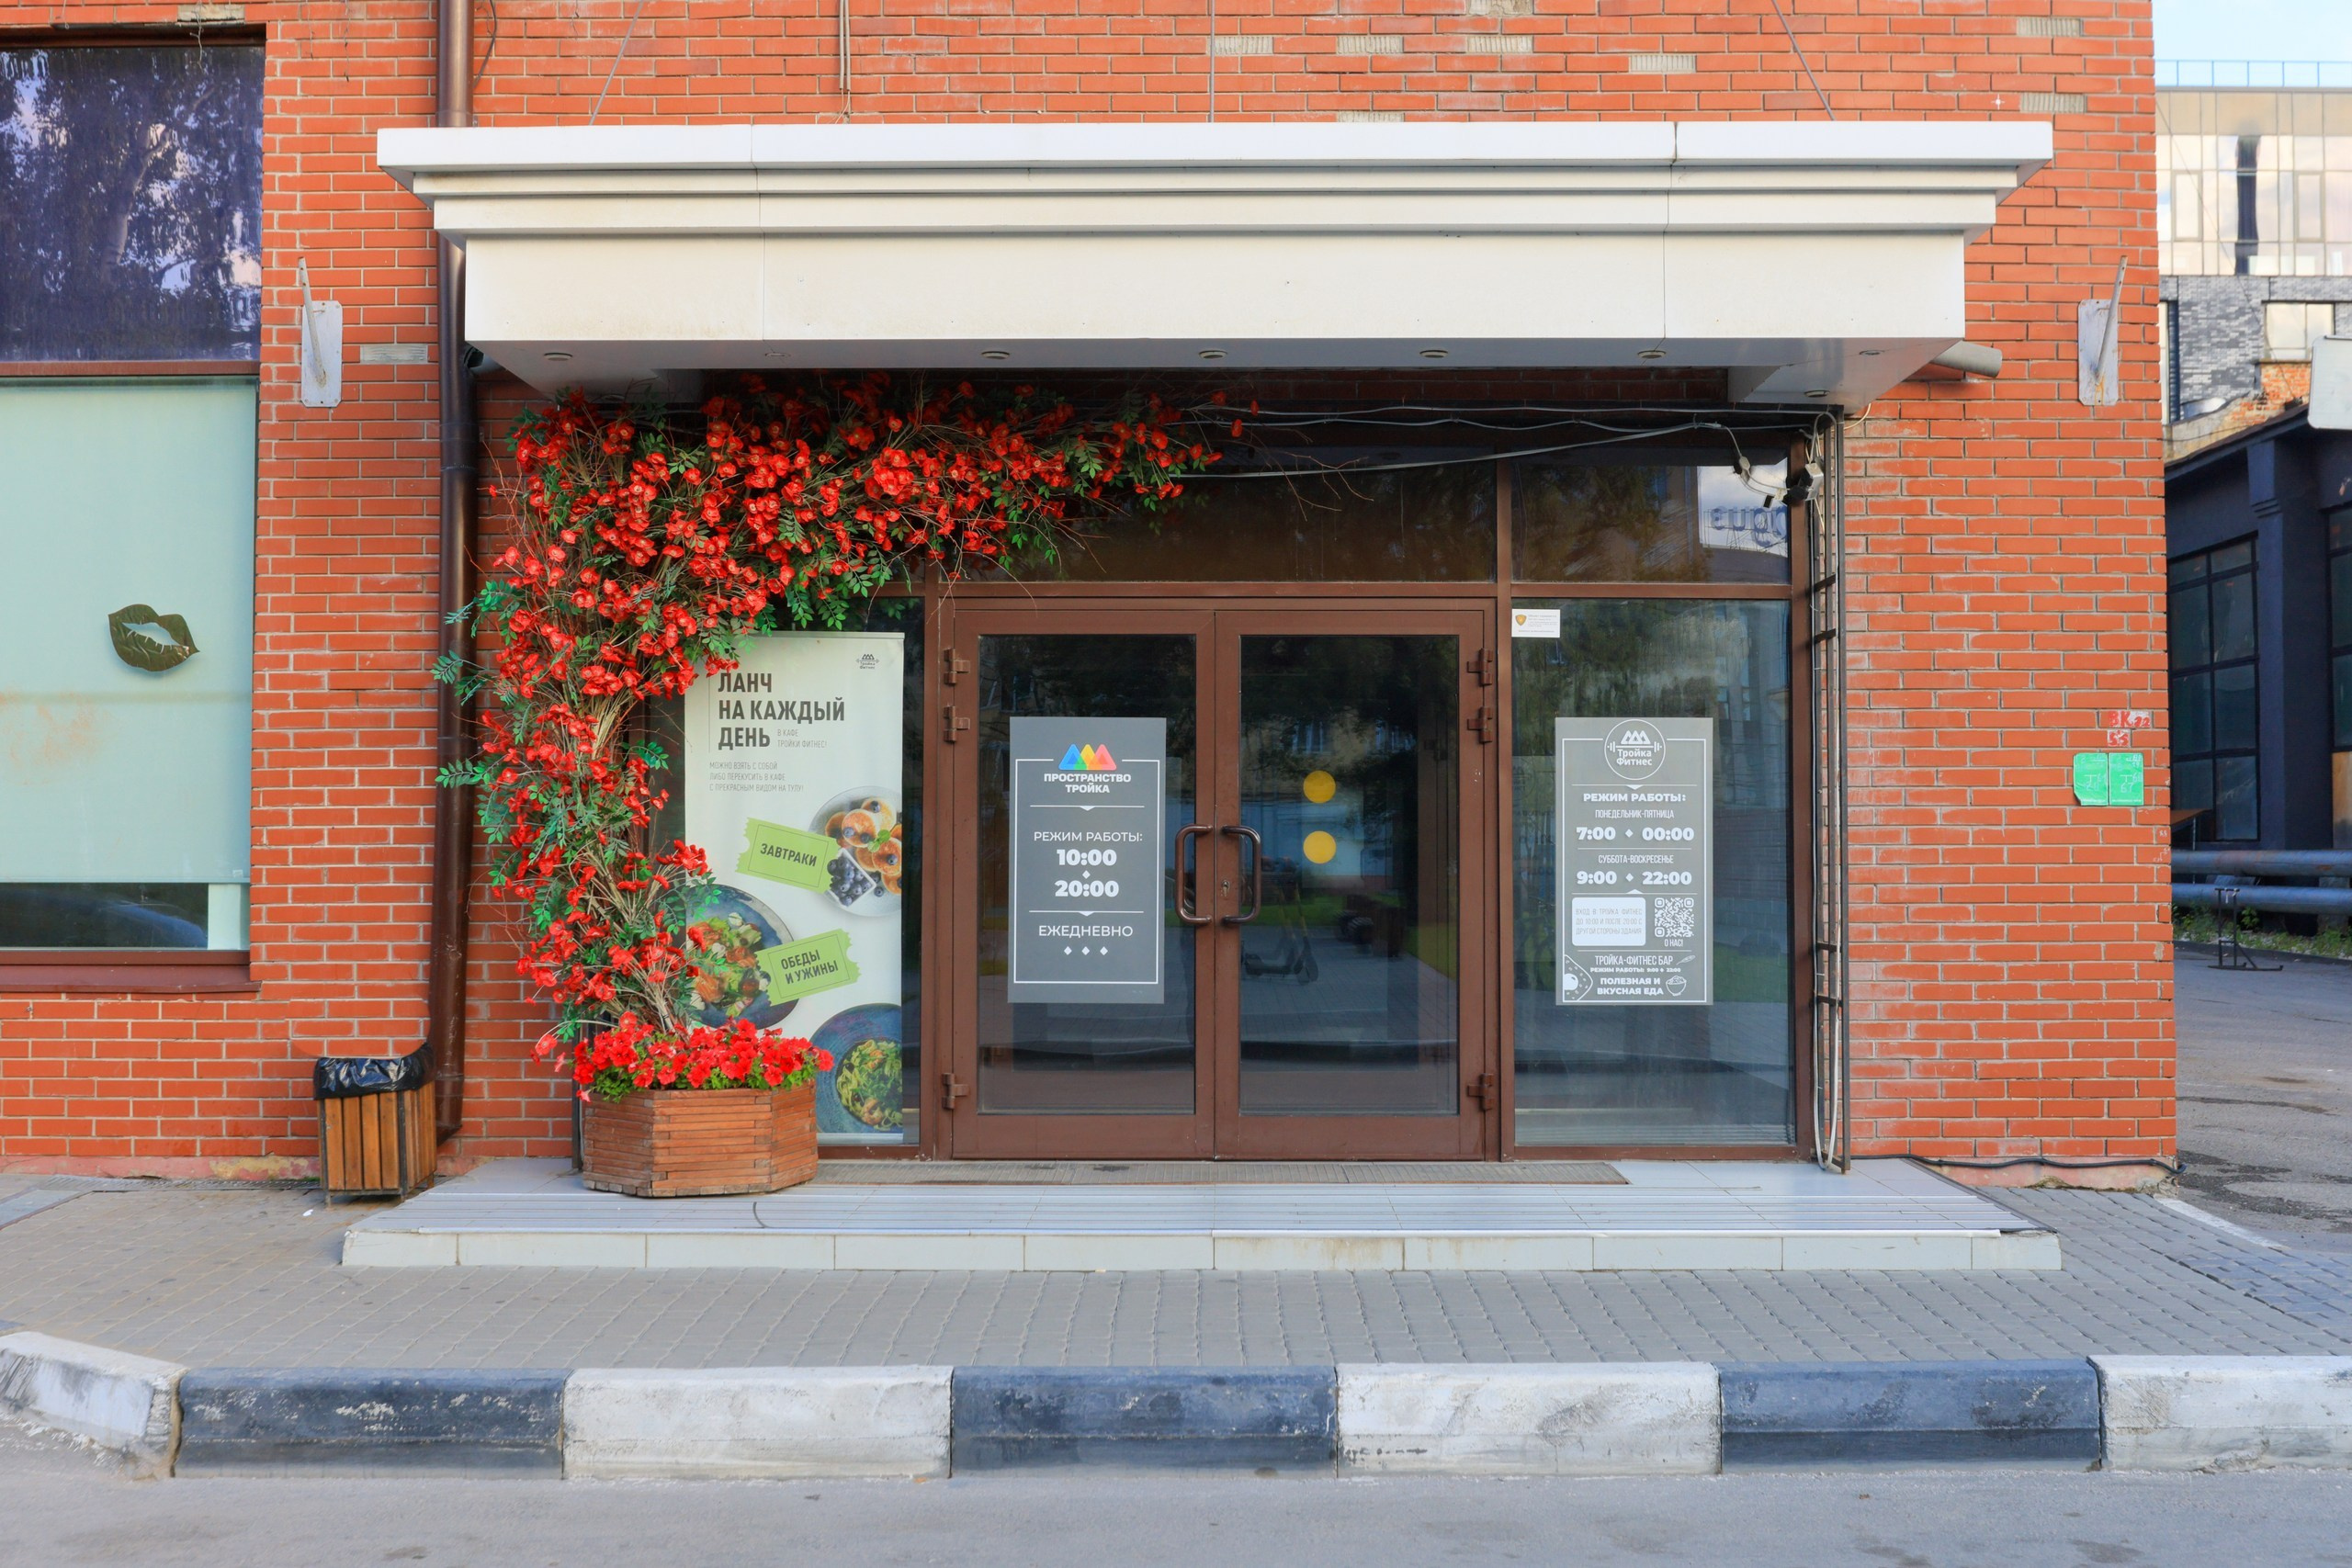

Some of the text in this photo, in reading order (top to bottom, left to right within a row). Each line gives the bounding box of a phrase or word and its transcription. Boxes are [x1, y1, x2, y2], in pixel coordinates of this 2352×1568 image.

[718, 672, 773, 693] ЛАНЧ
[718, 696, 845, 724] НА КАЖДЫЙ
[777, 728, 799, 737] В КАФЕ
[718, 727, 771, 750] ДЕНЬ
[777, 739, 827, 749] ТРОЙКИ ФИТНЕС!
[1617, 749, 1652, 759] Тройка
[709, 760, 778, 770] МОЖНО ВЗЯТЬ С СОБОЙ
[1616, 758, 1653, 766] Фитнес
[709, 773, 726, 781] ЛИБО
[727, 773, 763, 781] ПЕРЕКУСИТЬ
[764, 773, 769, 781] В
[1044, 773, 1132, 784] ПРОСТРАНСТВО
[709, 783, 714, 791] С
[715, 784, 754, 792] ПРЕКРАСНЫМ
[755, 784, 777, 793] ВИДОМ
[778, 784, 786, 792] НА
[1065, 782, 1110, 794] ТРОЙКА
[1583, 793, 1687, 802] РЕЖИМ РАБОТЫ:
[1595, 809, 1675, 819] ПОНЕДЕЛЬНИК-ПЯТНИЦА
[1034, 831, 1143, 842] РЕЖИМ РАБОТЫ:
[1576, 827, 1695, 840] 7:00 00:00
[760, 842, 817, 867] ЗАВТРАКИ
[1057, 849, 1117, 866] 10:00
[1598, 854, 1674, 863] СУББОТА-ВОСКРЕСЕНЬЕ
[1577, 871, 1692, 886] 9:00 22:00
[1055, 880, 1120, 897] 20:00
[1038, 925, 1134, 938] ЕЖЕДНЕВНО
[1664, 939, 1683, 947] О НАС!
[781, 949, 820, 970] ОБЕДЫ
[1595, 954, 1674, 965] ТРОЙКА-ФИТНЕС БАР
[785, 960, 839, 985] И УЖИНЫ
[1600, 977, 1661, 986] ПОЛЕЗНАЯ И
[1597, 987, 1664, 996] ВКУСНАЯ ЕДА
